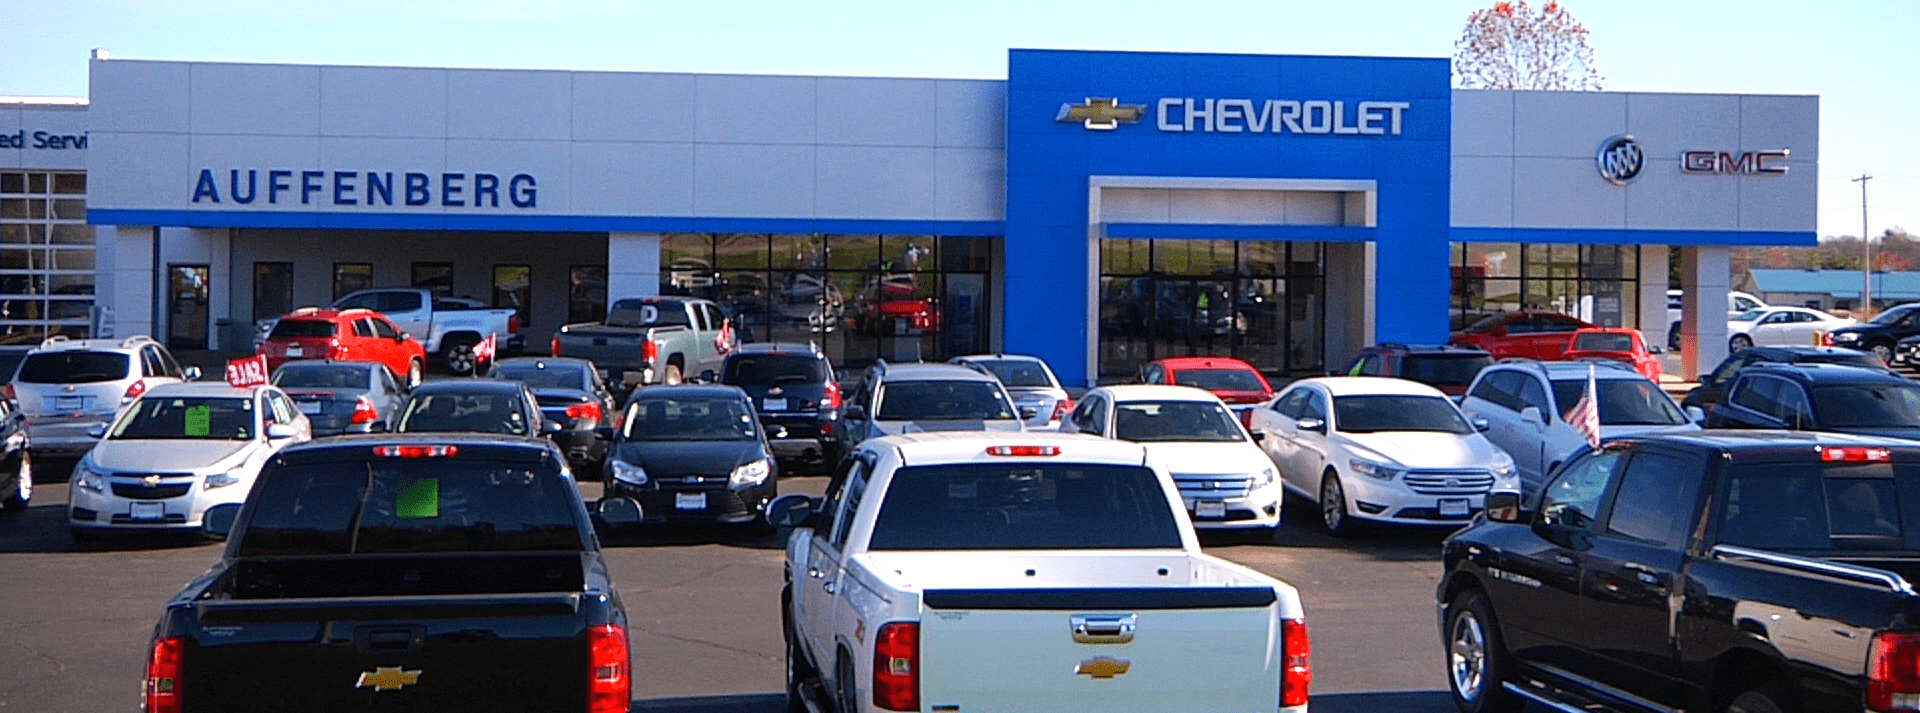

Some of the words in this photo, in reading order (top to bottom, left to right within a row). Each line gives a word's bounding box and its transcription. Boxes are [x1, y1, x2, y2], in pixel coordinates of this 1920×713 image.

[1157, 98, 1410, 135] CHEVROLET
[32, 130, 88, 149] Servi
[1680, 149, 1790, 174] GMC
[192, 169, 538, 208] AUFFENBERG
